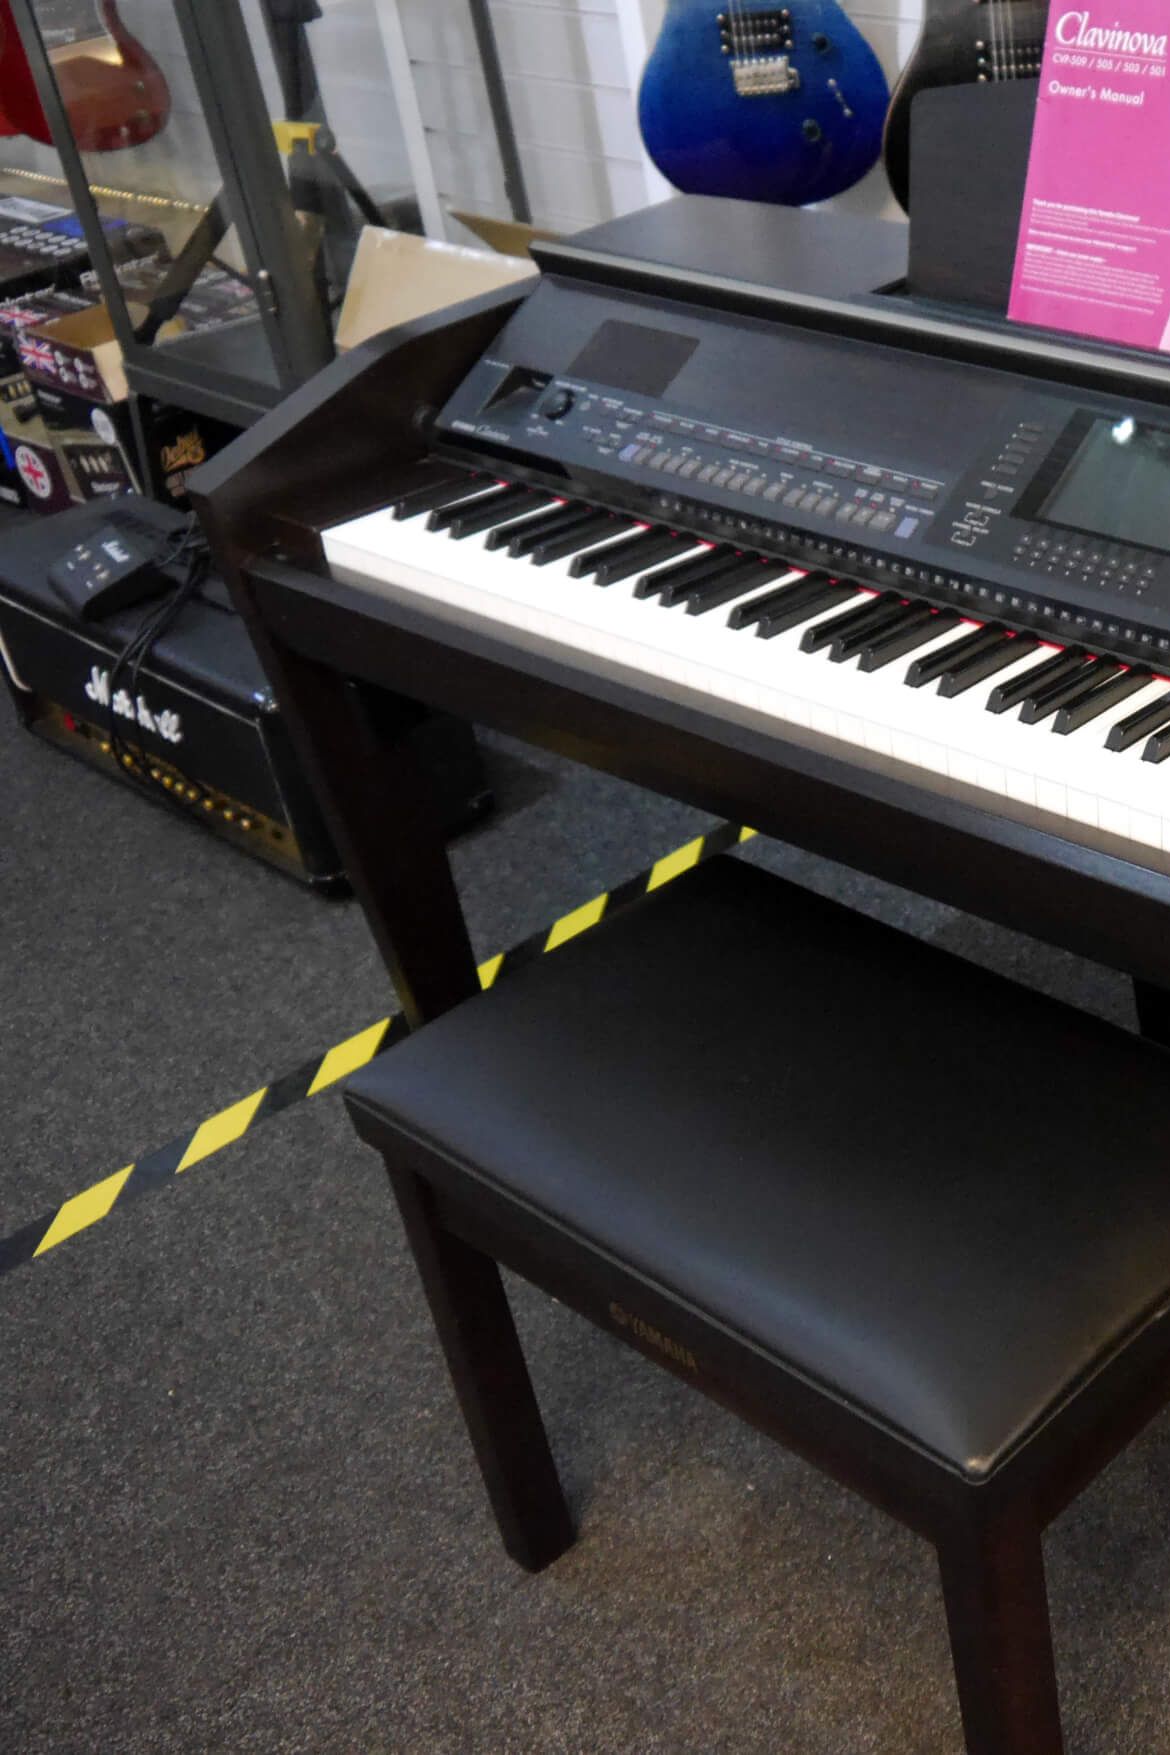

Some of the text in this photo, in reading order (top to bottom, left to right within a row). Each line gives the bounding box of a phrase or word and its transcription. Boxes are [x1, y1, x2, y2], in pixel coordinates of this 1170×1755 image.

[1055, 10, 1168, 57] Clavinova
[1052, 53, 1088, 66] CVP-509
[1048, 80, 1145, 105] Owner's Manual
